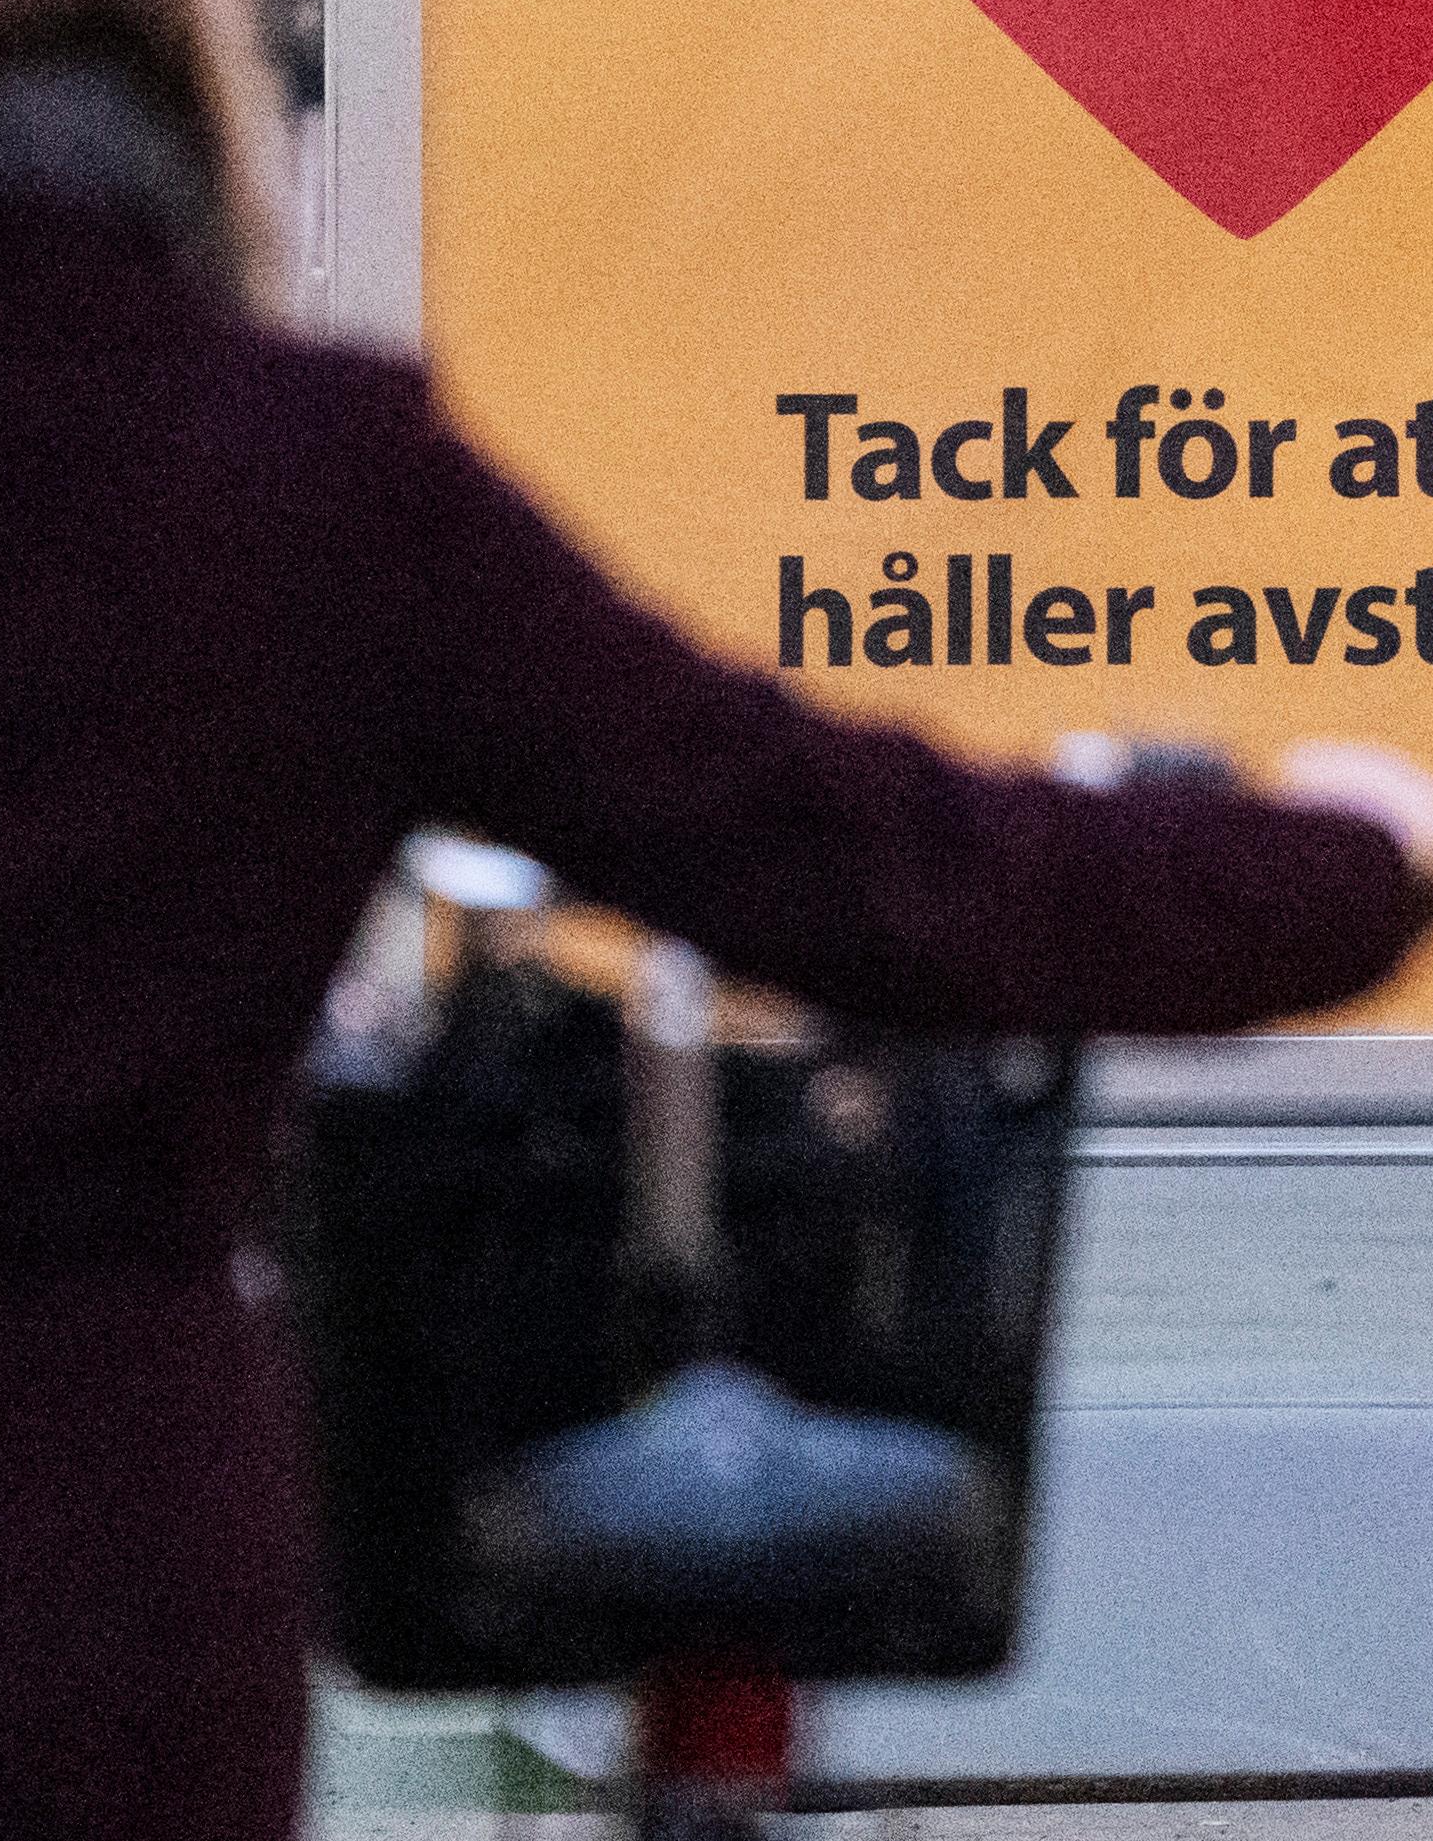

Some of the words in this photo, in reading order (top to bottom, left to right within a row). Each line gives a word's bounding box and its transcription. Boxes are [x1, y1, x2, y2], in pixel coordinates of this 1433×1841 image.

[775, 386, 1079, 501] Tack
[1106, 385, 1296, 500] för
[778, 551, 1155, 668] håller
